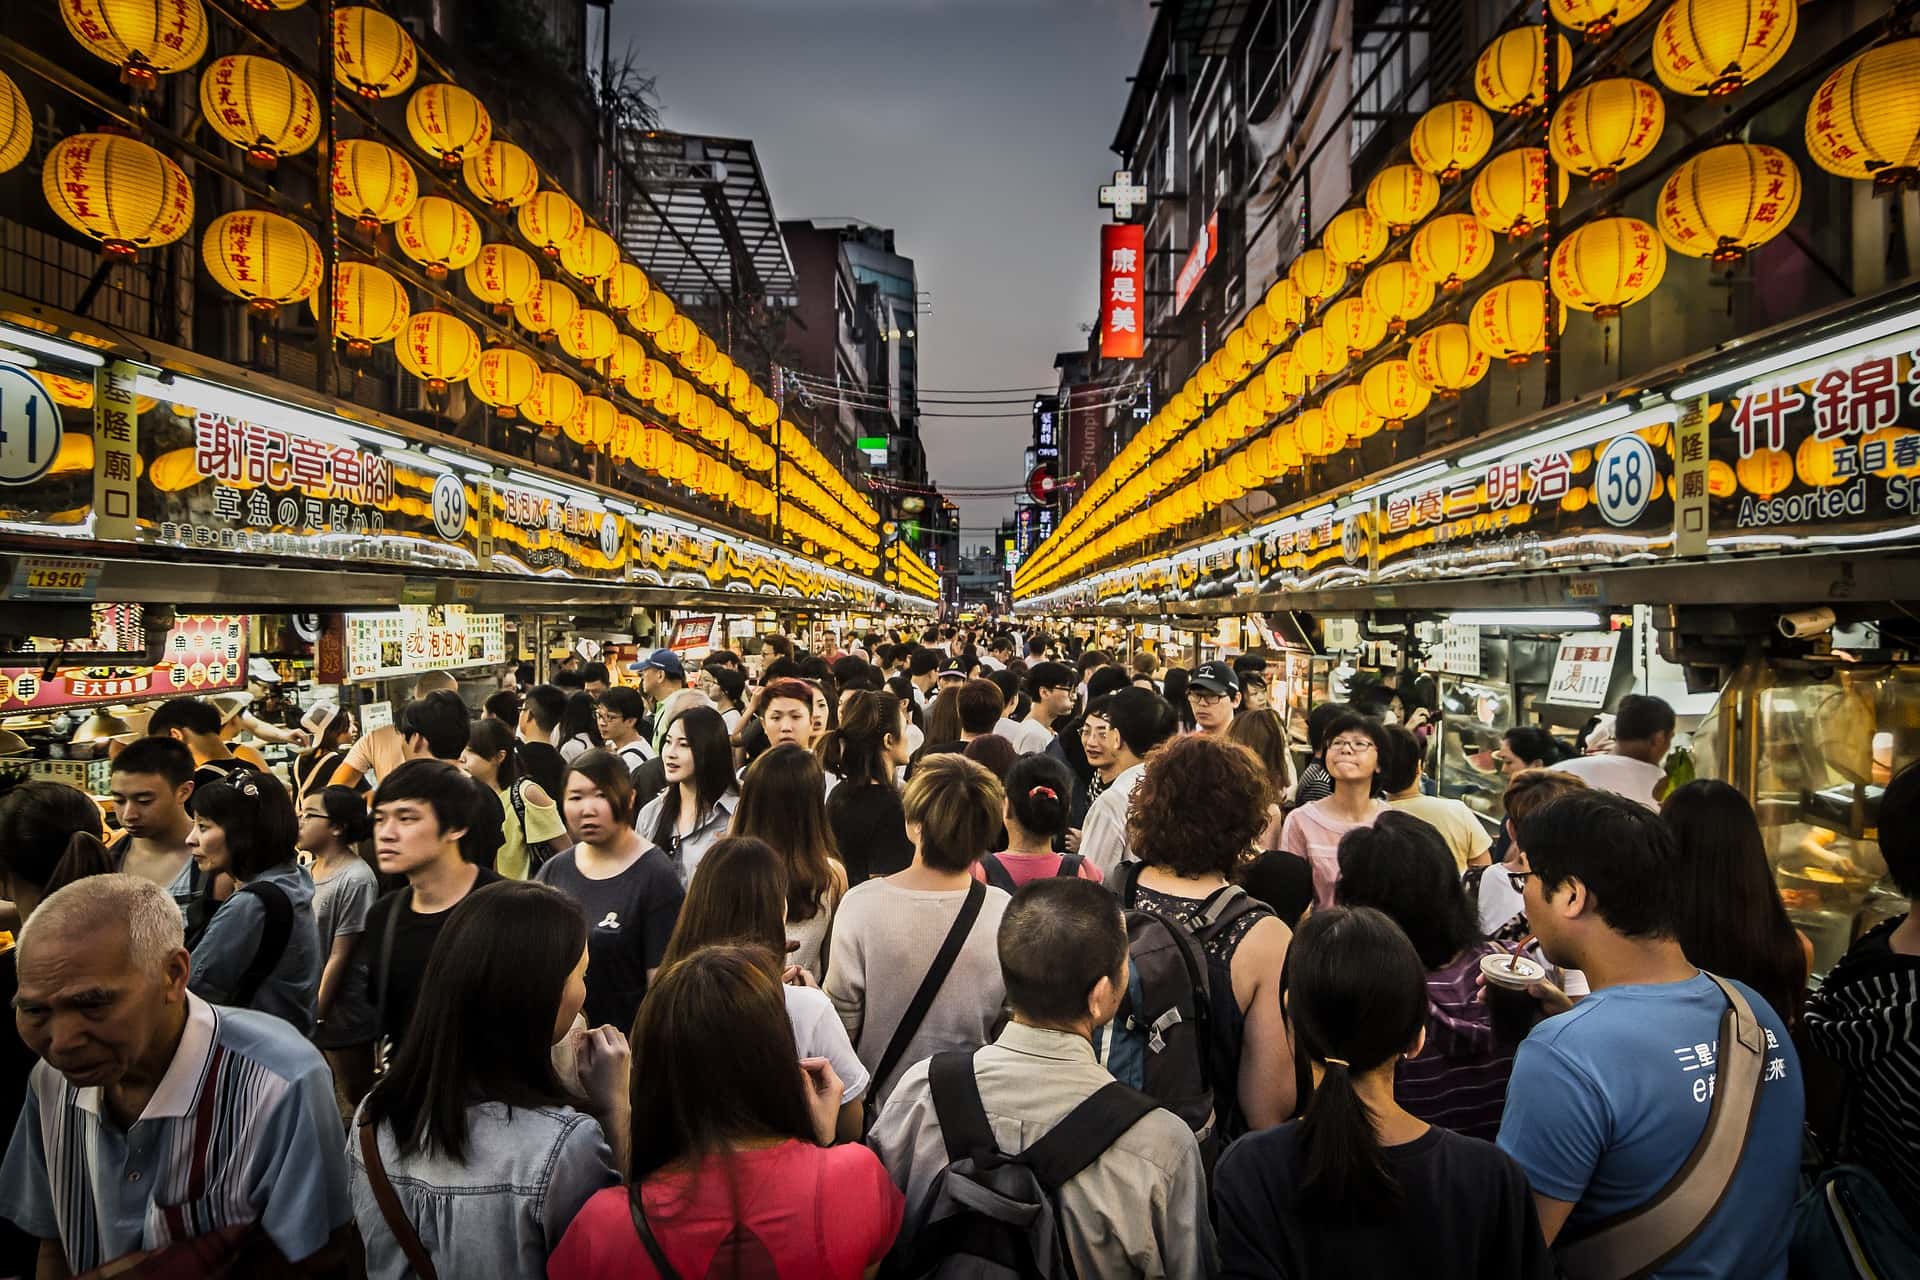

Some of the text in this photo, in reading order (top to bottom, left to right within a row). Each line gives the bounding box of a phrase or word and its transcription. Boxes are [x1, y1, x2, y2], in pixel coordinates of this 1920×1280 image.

[1111, 248, 1136, 333] 康是美
[0, 386, 37, 463] 1
[1733, 350, 1920, 457] 什錦
[104, 370, 131, 518] 基隆廟口
[197, 412, 396, 506] 謝記章魚腳
[1681, 397, 1705, 533] 基隆廟口
[213, 486, 385, 536] 章魚の足ばかり
[440, 486, 462, 526] 39
[1388, 451, 1571, 531] 營養三明治
[1607, 450, 1642, 511] 58
[1737, 478, 1866, 528] Assorted
[604, 523, 616, 553] 37
[36, 570, 82, 587] 1950
[428, 628, 466, 658] 泡泡冰
